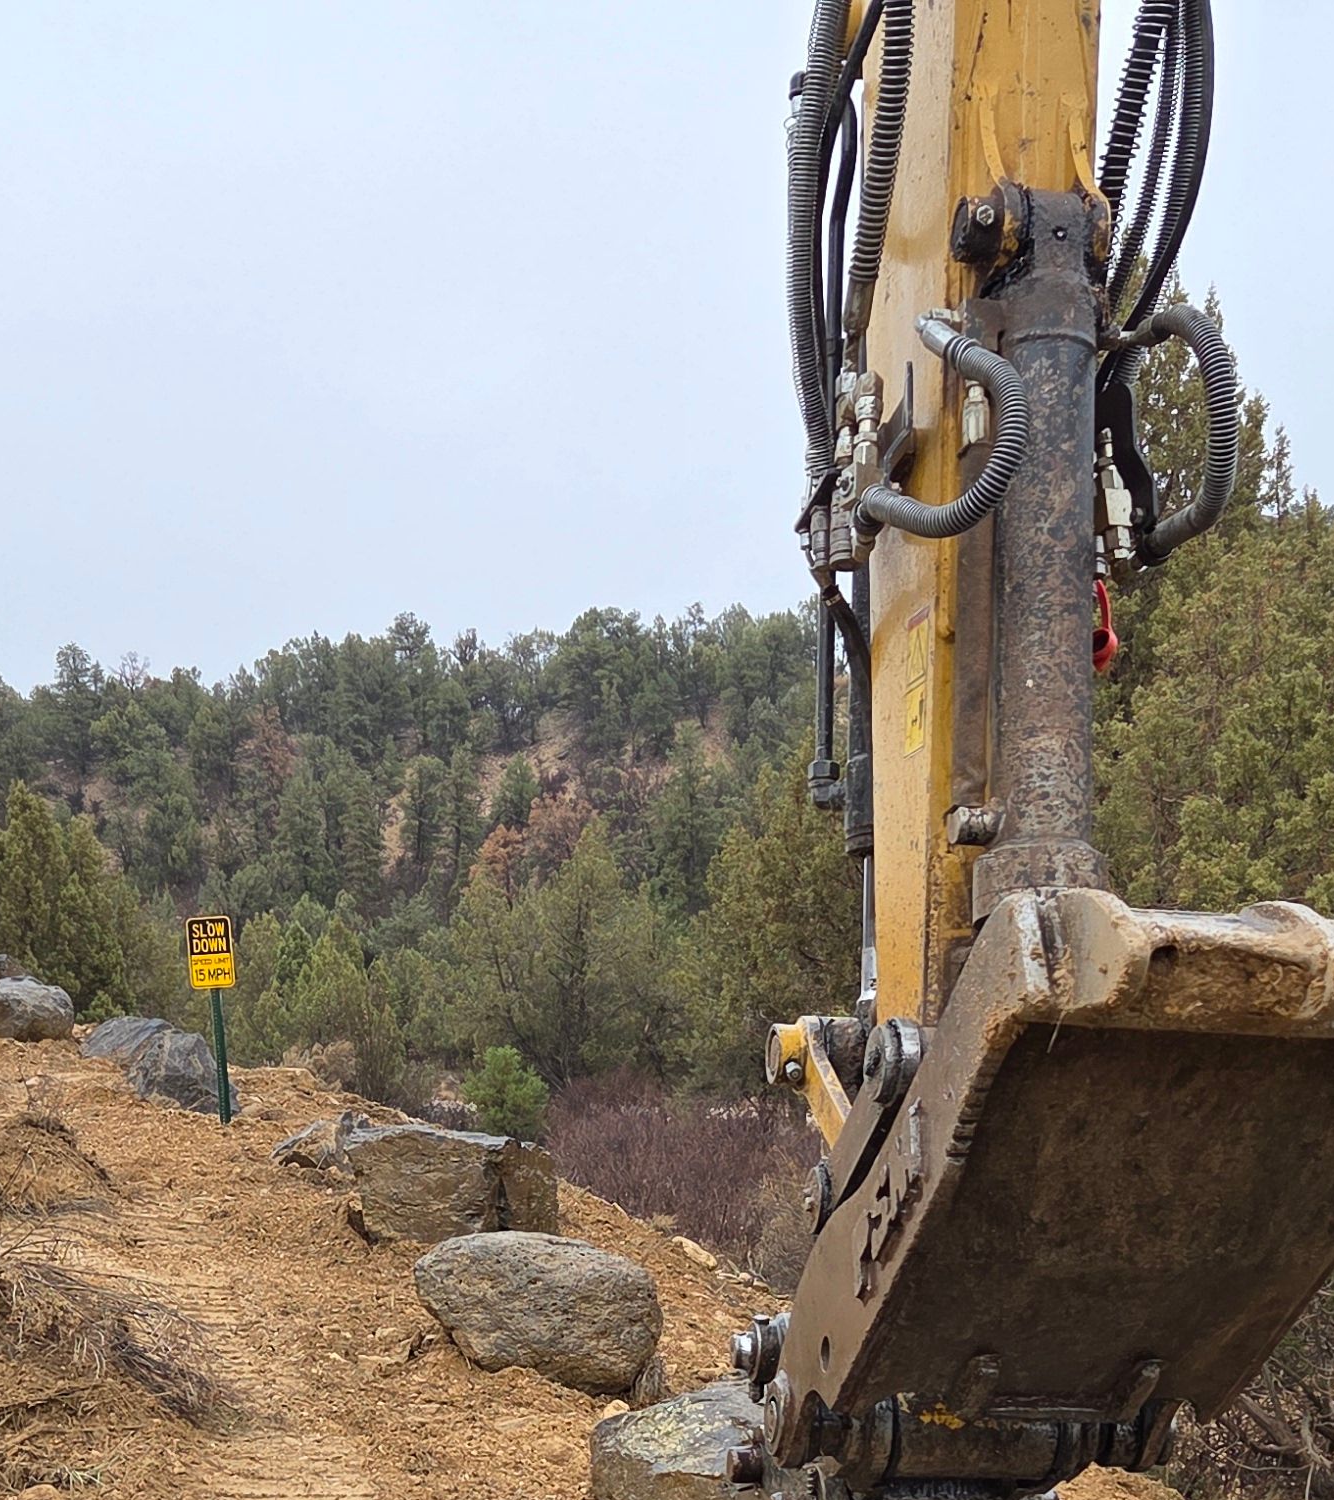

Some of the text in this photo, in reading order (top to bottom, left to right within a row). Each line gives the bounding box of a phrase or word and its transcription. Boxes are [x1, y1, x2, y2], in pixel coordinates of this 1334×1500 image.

[192, 922, 224, 937] SLOW
[192, 937, 226, 952] DOWN
[195, 968, 230, 981] 15 MPH
